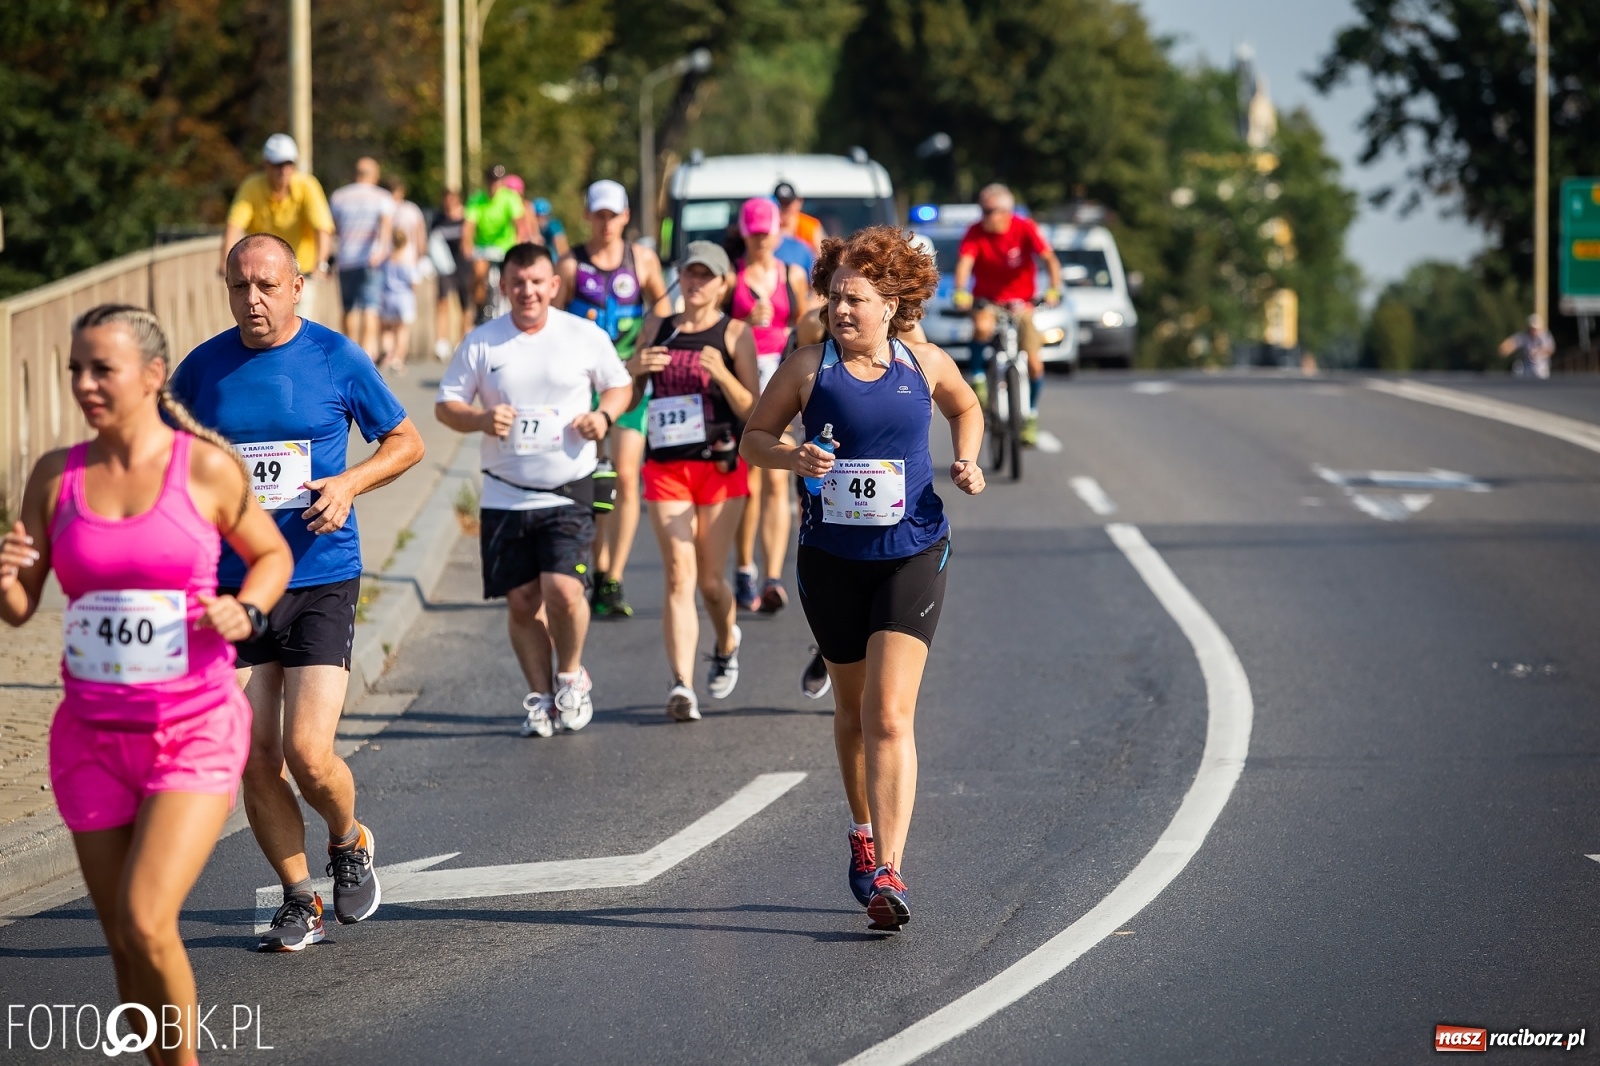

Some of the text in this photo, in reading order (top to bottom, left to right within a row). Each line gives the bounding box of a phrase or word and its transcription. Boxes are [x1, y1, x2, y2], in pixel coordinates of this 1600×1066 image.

[521, 420, 539, 434] 77
[658, 409, 687, 427] 323
[252, 460, 282, 483] 49
[848, 477, 876, 499] 48
[97, 615, 154, 647] 460
